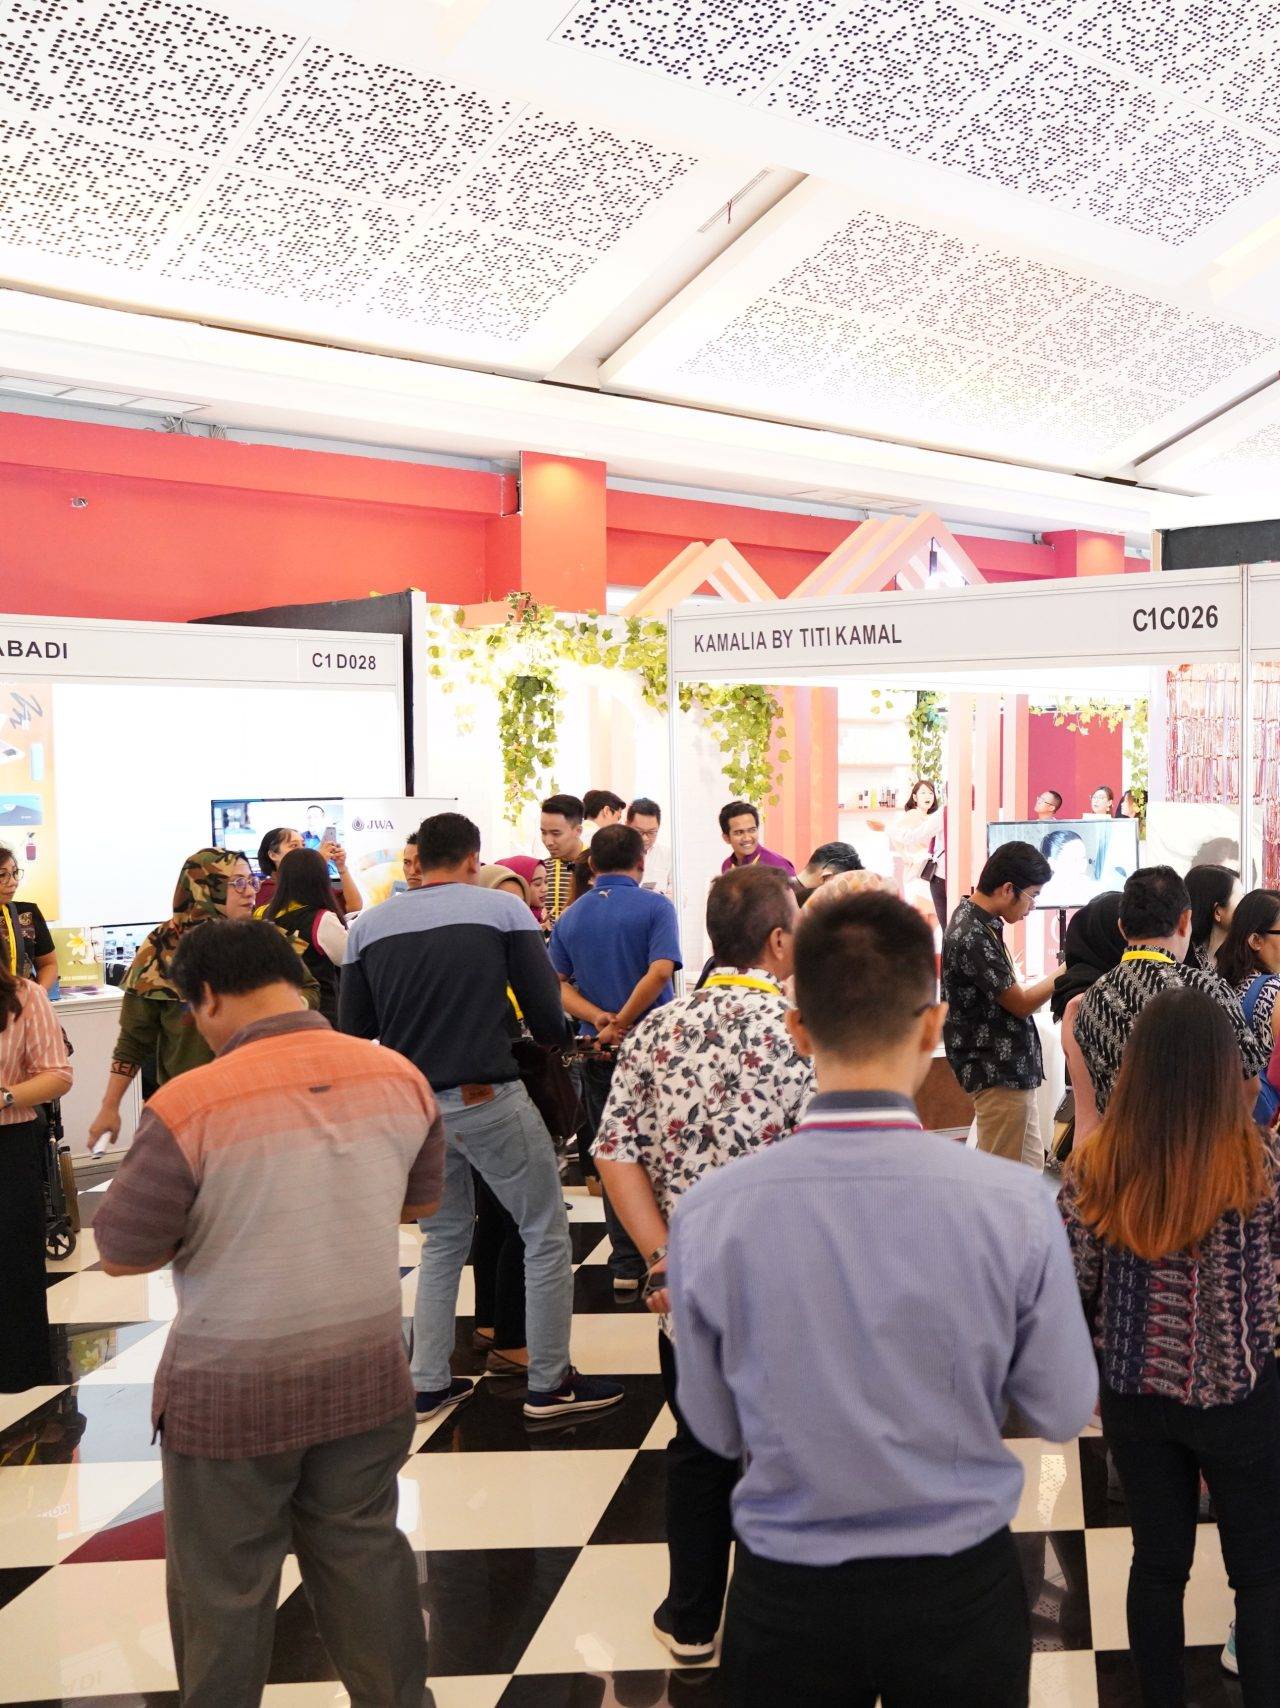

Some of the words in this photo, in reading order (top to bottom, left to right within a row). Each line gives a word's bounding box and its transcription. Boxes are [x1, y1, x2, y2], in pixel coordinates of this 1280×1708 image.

[1132, 604, 1219, 632] C1C026
[694, 630, 767, 653] KAMALIA
[772, 629, 793, 649] BY
[799, 626, 831, 648] TITI
[835, 623, 902, 646] KAMAL
[312, 652, 331, 668] C1
[336, 653, 376, 671] D028
[367, 819, 394, 830] JWA
